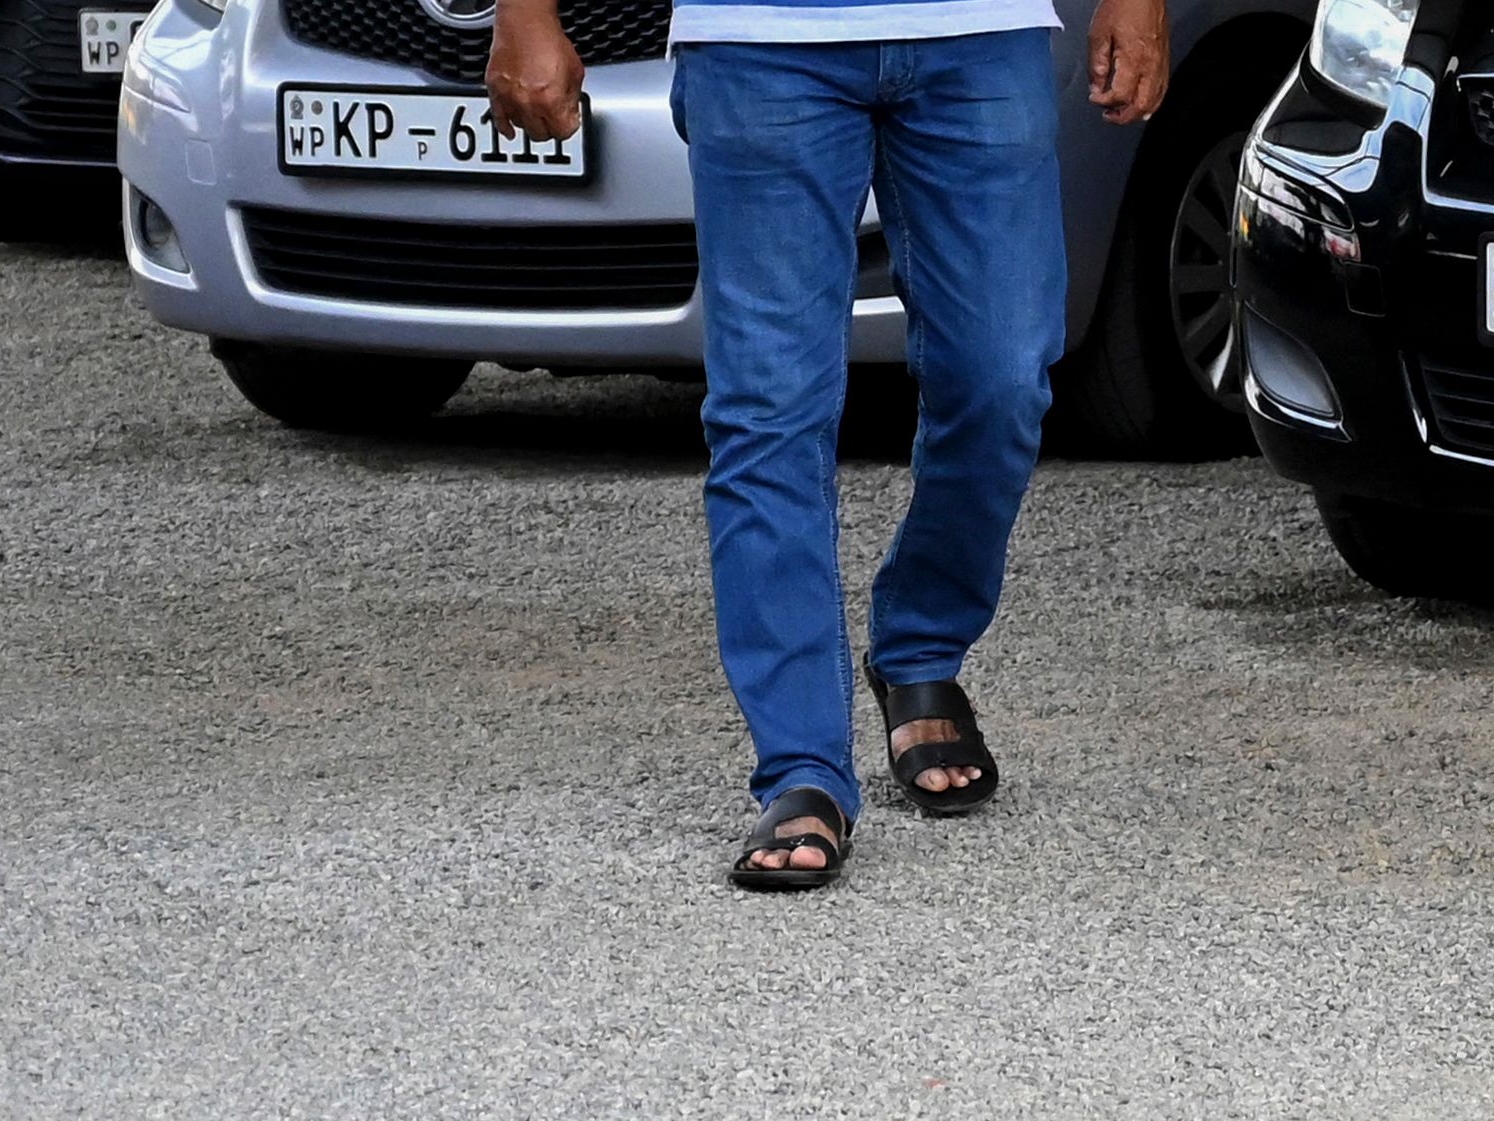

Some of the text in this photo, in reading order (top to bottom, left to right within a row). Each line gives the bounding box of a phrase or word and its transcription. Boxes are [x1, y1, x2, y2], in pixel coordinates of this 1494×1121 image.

[87, 41, 120, 65] WP
[289, 125, 325, 157] WP
[332, 100, 395, 158] KP
